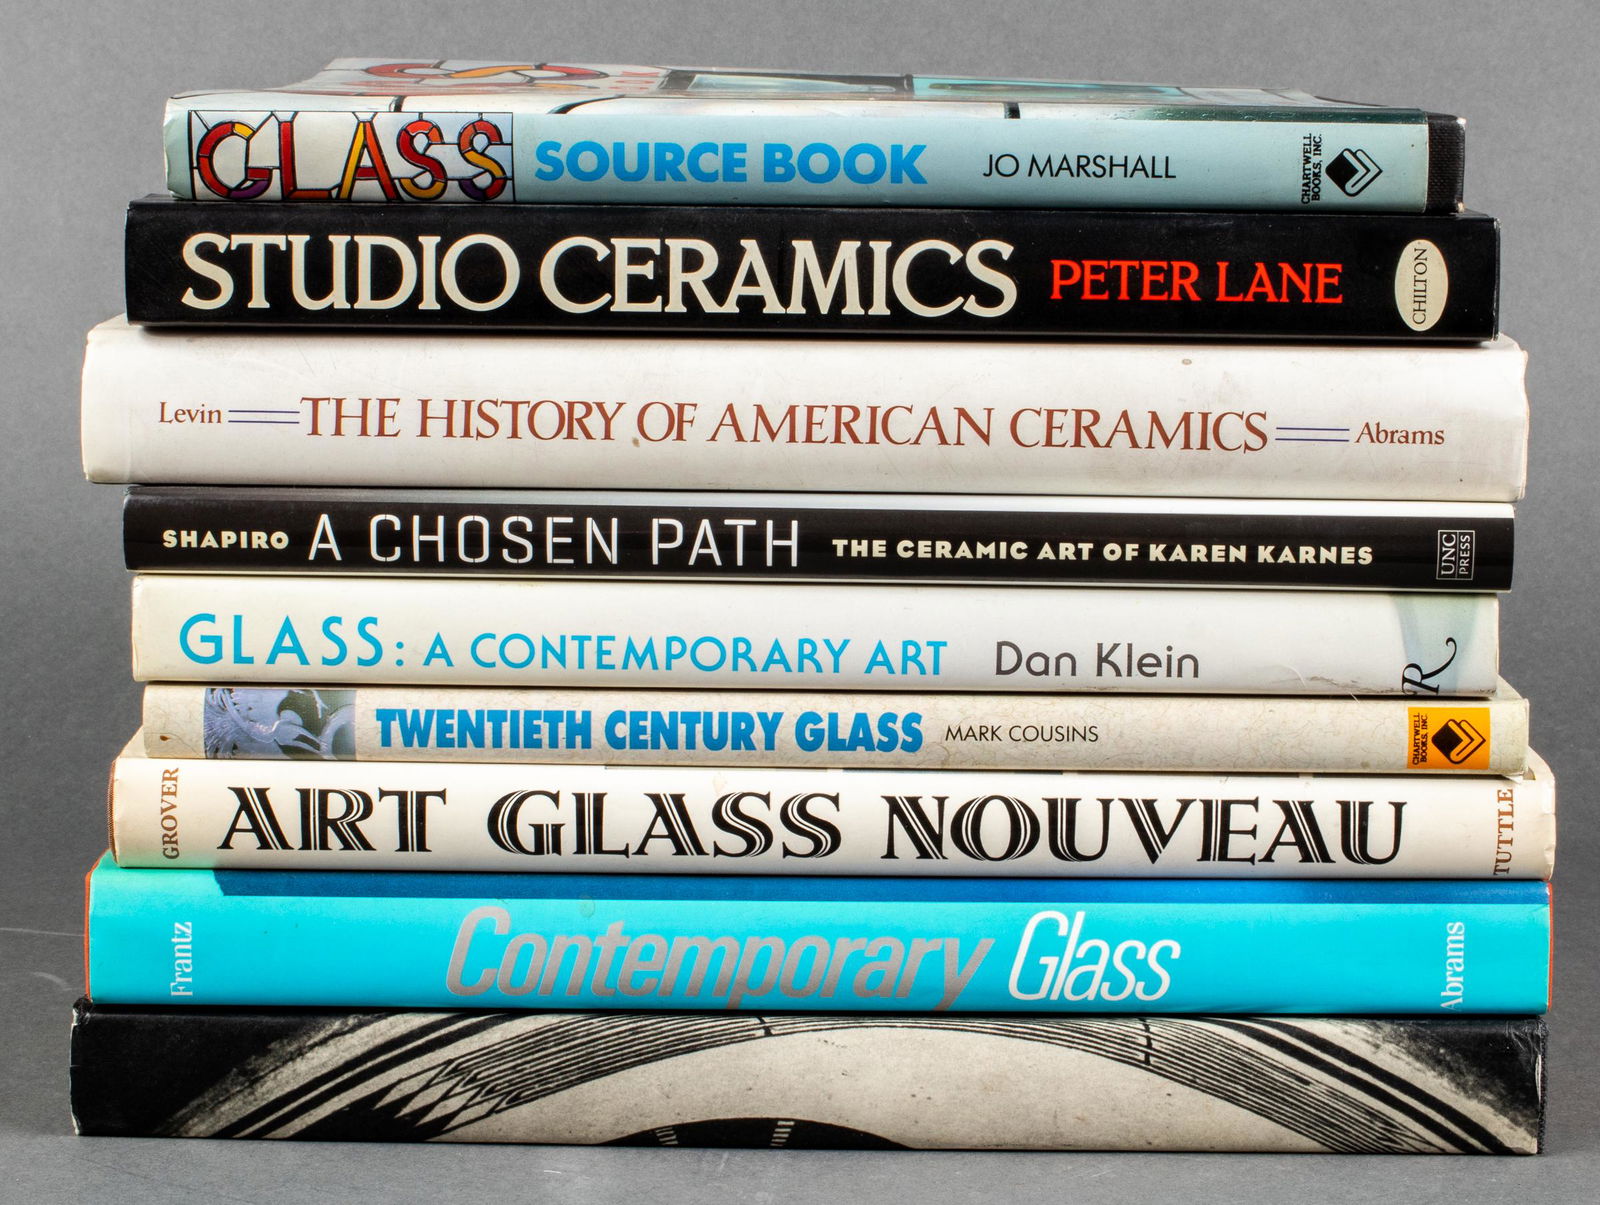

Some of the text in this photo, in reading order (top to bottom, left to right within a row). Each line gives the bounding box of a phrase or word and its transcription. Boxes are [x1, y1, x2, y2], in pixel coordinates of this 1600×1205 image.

[198, 120, 929, 200] GLASS SOURCE BOOK
[983, 153, 1177, 179] JO MARSHALL
[1300, 132, 1312, 205] CHARTWELL
[181, 232, 1018, 318] STUDIO CERAMICS
[1050, 259, 1343, 304] PETER LANE
[1412, 247, 1428, 325] CHILTON
[159, 401, 222, 424] Levin
[300, 396, 1268, 453] THE HISTORY OF AMERICAN CERAMICS
[1355, 421, 1445, 445] Abrams
[162, 529, 289, 550] SHAPIRO
[308, 513, 799, 567] A CHOSEN PATH
[831, 539, 1373, 565] THE CERAMIC ART OF KAREN KARNES
[1441, 533, 1456, 576] UNC
[1458, 535, 1471, 575] PRESS
[179, 612, 948, 676] GLASS: A CONTEMPORARY ART
[995, 640, 1199, 679] Dan Klein
[375, 708, 924, 753] TWENTIETH CENTURY GLASS
[945, 725, 1099, 743] MARK COUSINS
[1412, 712, 1421, 765] CHARTWELL
[160, 767, 180, 860] GROVER
[216, 786, 1407, 866] ART GLASS NOUVEAU
[1493, 788, 1514, 876] TUTTLE
[169, 921, 193, 996] Frantz
[445, 906, 1182, 1011] Contemporary Glass
[1440, 921, 1465, 1012] Abrams
